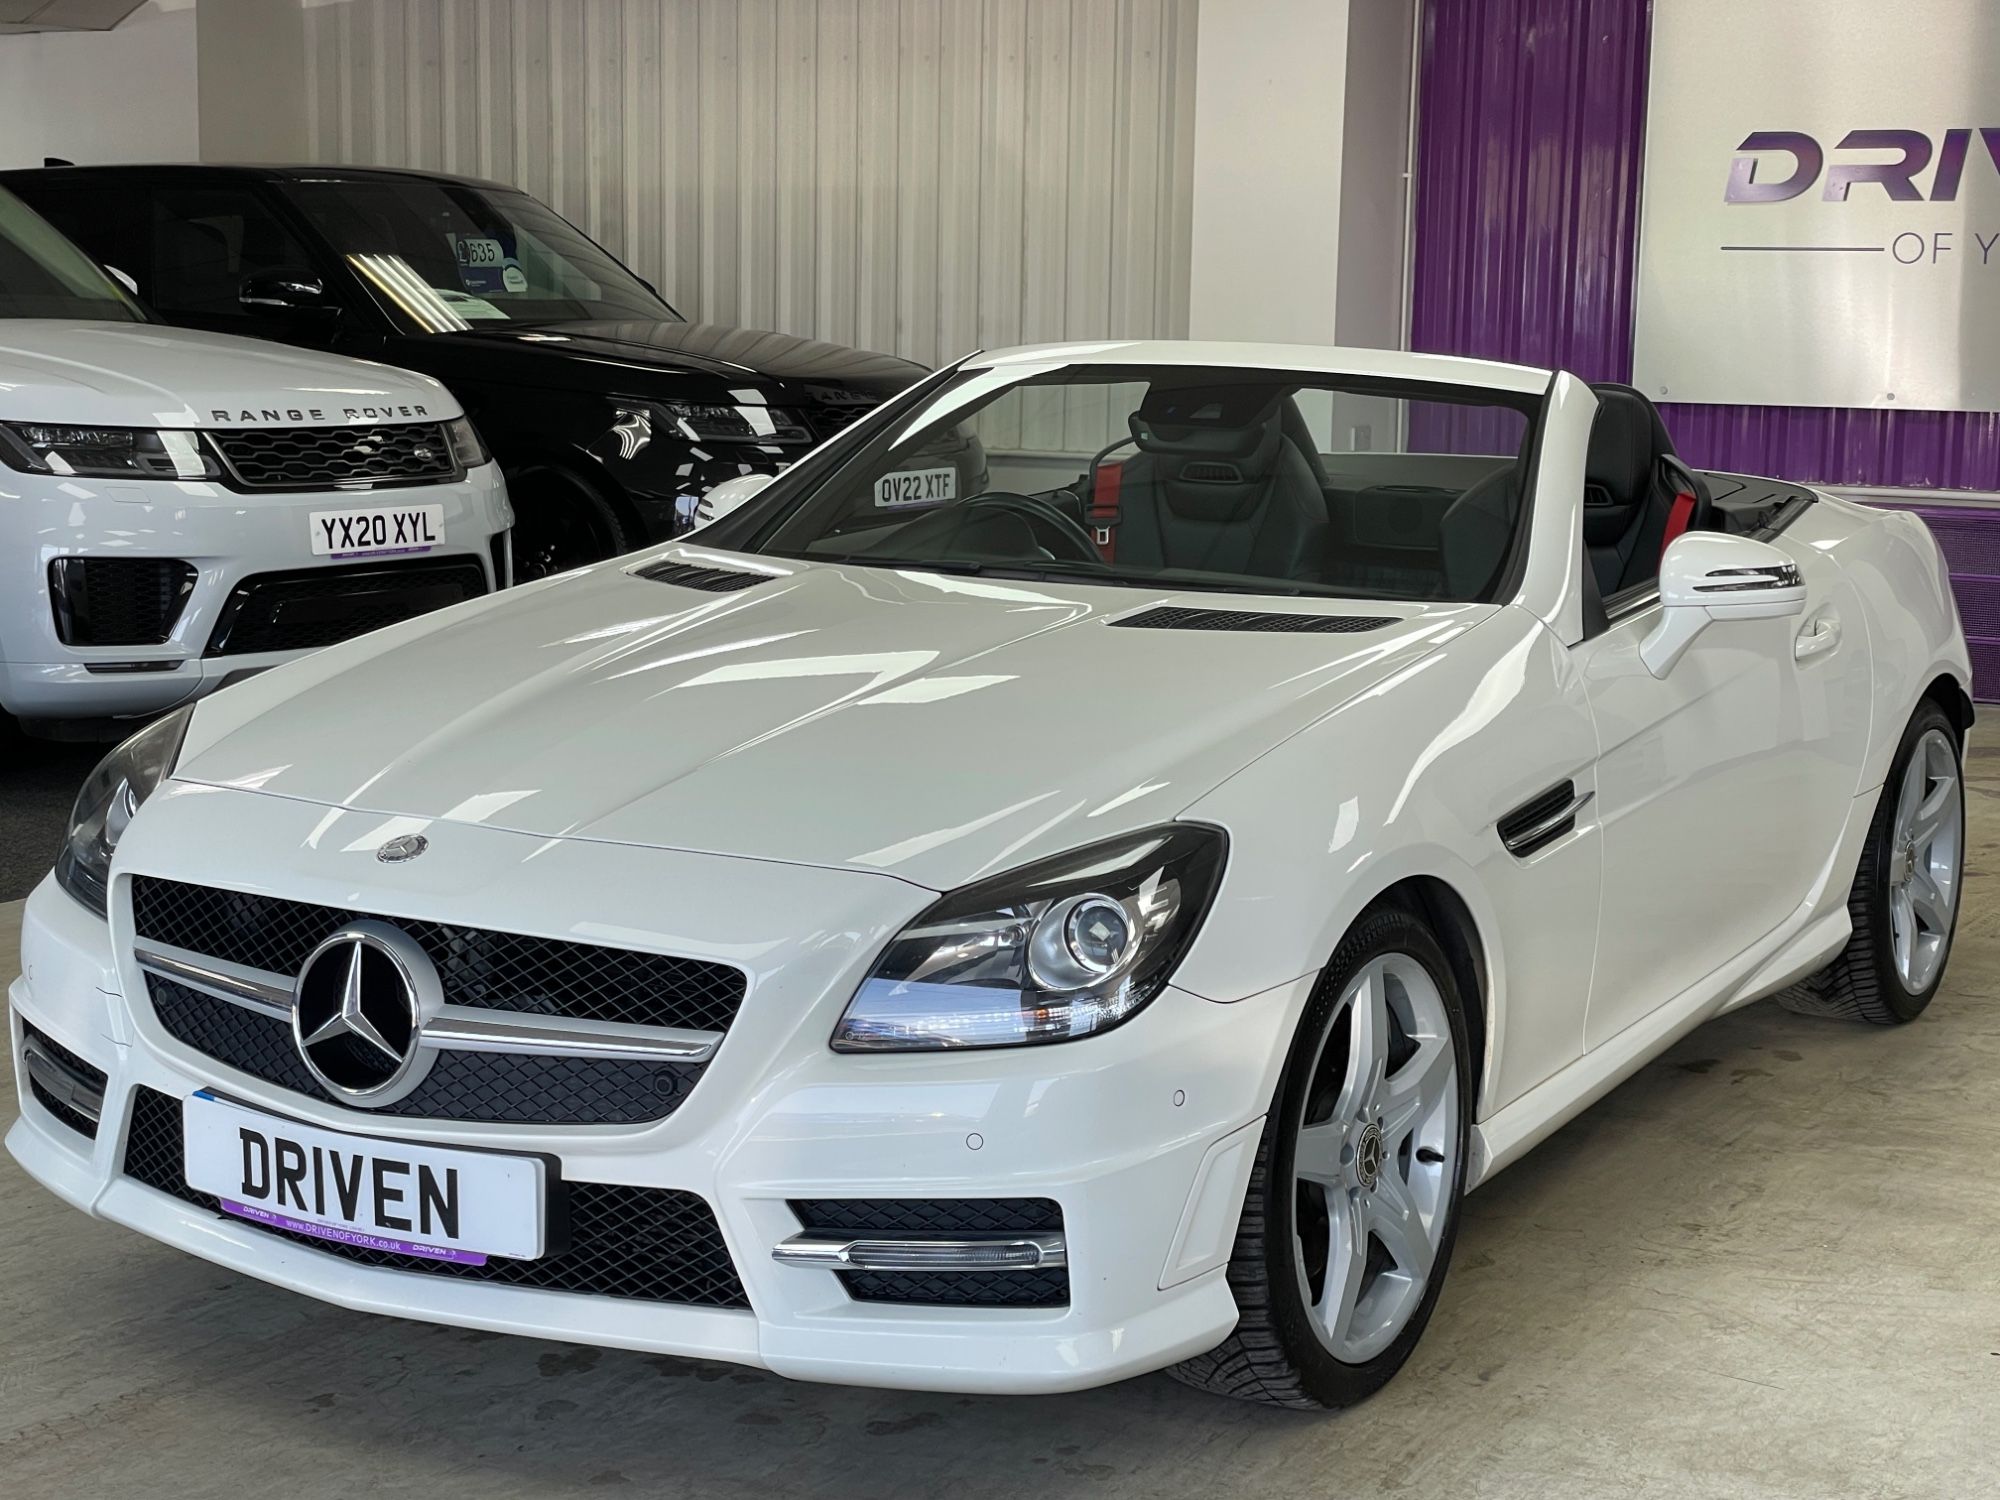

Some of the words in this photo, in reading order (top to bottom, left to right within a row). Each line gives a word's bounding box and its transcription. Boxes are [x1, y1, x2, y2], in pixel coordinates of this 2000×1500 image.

[1724, 127, 2000, 204] DRI
[1892, 232, 1953, 264] OF
[211, 409, 325, 422] RANGE
[343, 405, 428, 420] ROVER
[882, 476, 922, 502] OV22
[925, 473, 950, 499] XTF
[321, 514, 387, 550] YX20
[393, 511, 436, 544] XYL
[239, 1126, 460, 1239] DRIVEN
[285, 1219, 401, 1251] www.DRIVENOFYORK.co.uk
[412, 1243, 447, 1256] DRIVEN
